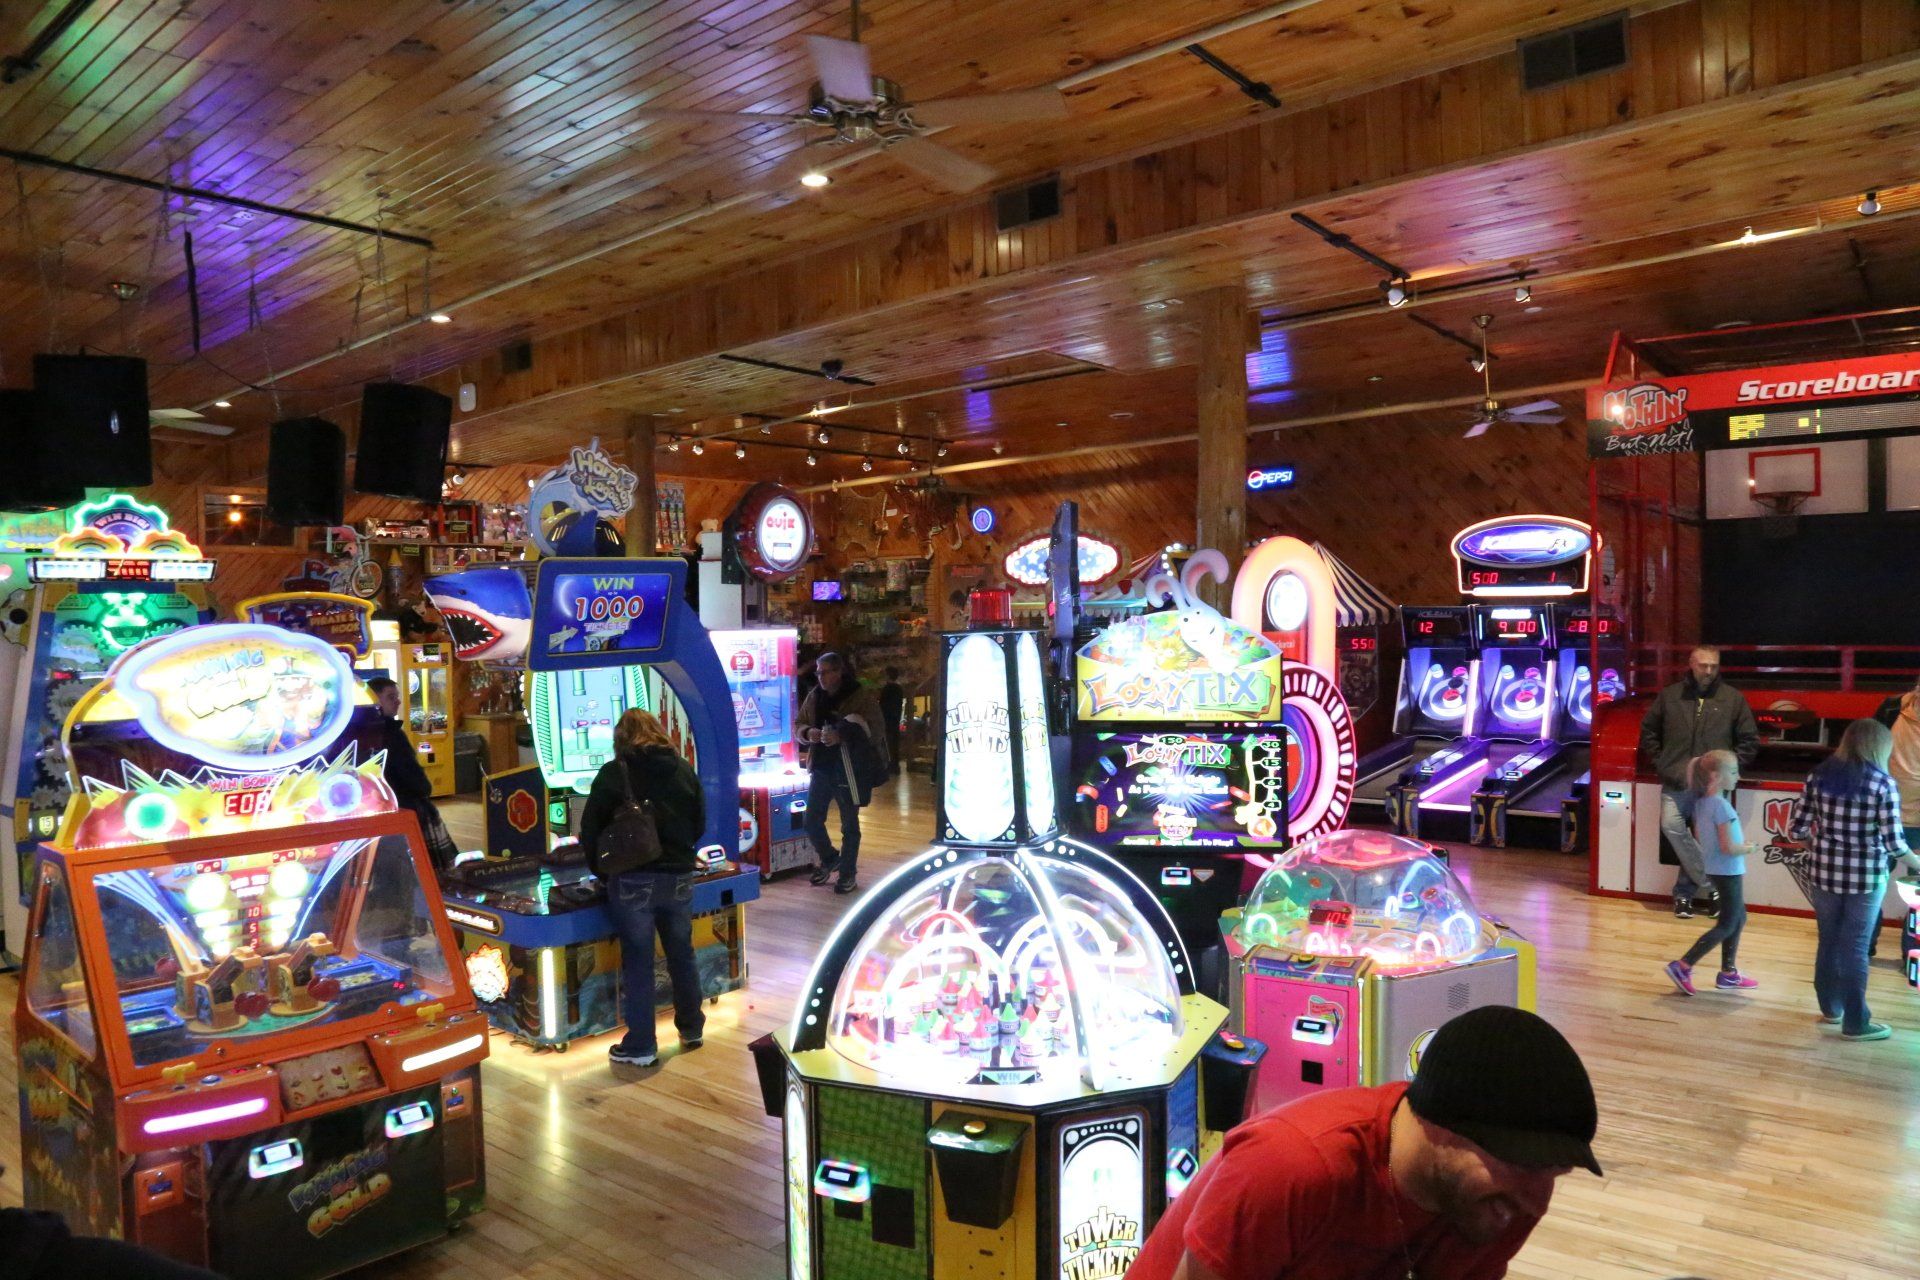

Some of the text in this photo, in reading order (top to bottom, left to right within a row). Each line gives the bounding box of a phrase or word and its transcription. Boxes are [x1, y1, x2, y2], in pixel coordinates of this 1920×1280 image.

[1604, 428, 1694, 452] But Net!
[1262, 470, 1293, 483] PEPSI
[592, 577, 635, 591] WIN
[575, 595, 644, 621] 1000
[1418, 621, 1434, 633] 12
[1190, 671, 1259, 706] TIX
[946, 700, 1009, 726] TOWER
[946, 726, 1010, 753] TICKETS
[1161, 736, 1183, 744] 150
[1185, 744, 1226, 765] TIX
[1264, 758, 1279, 766] 15
[207, 778, 239, 793] WIN
[247, 905, 260, 917] 10
[249, 922, 257, 933] 5
[997, 1072, 1021, 1081] WIN
[1063, 1205, 1138, 1253] TOWER
[1062, 1245, 1140, 1280] TICKETS
